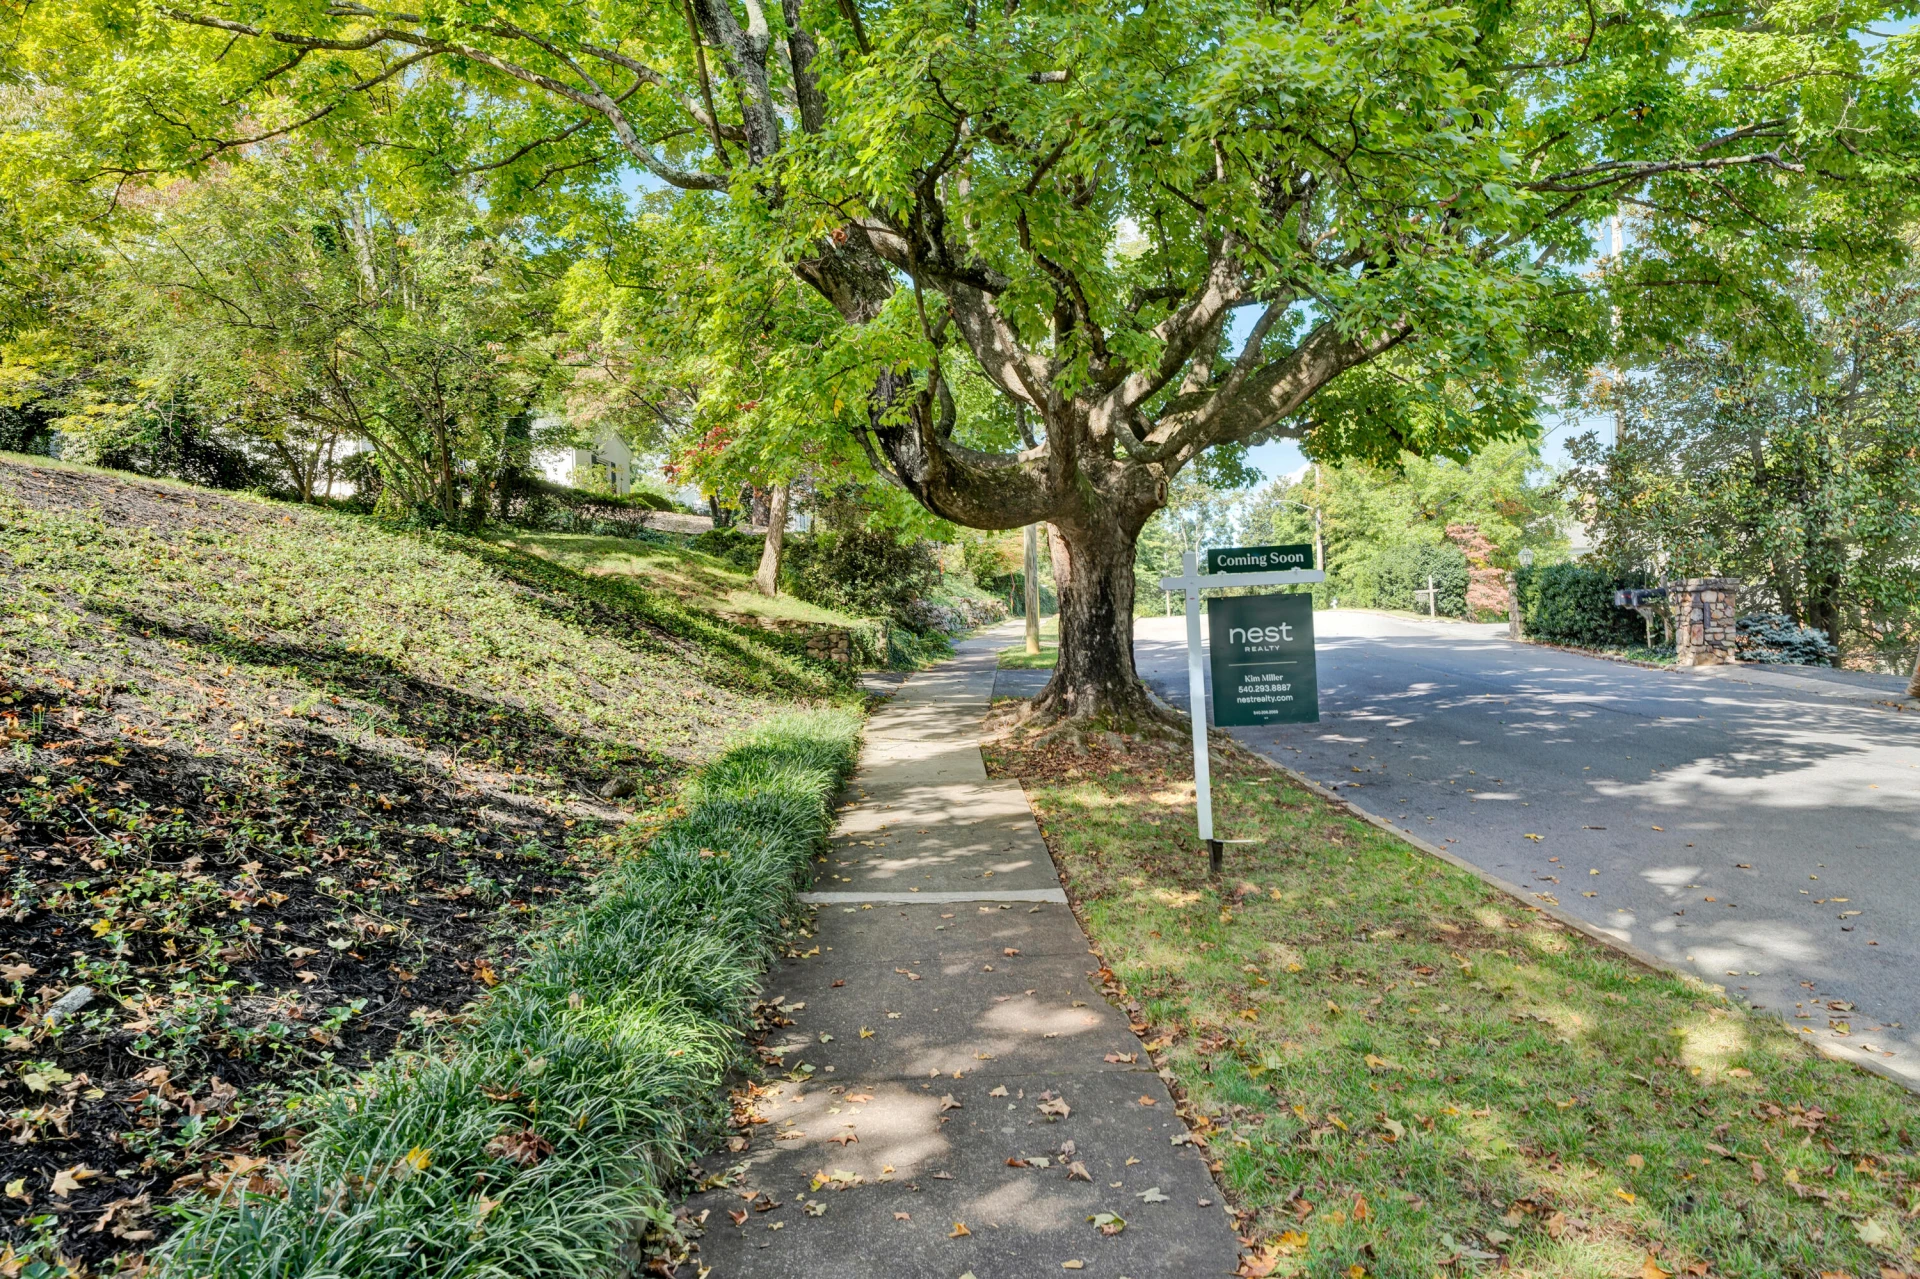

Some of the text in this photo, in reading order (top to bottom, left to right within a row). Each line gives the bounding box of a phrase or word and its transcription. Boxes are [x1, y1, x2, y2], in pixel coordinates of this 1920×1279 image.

[1217, 552, 1304, 567] Coming Soon
[1229, 622, 1293, 644] nest
[1244, 673, 1283, 682] Kim Miller
[1238, 684, 1291, 693] 540.293.8887
[1236, 695, 1293, 704] nestrealty.com
